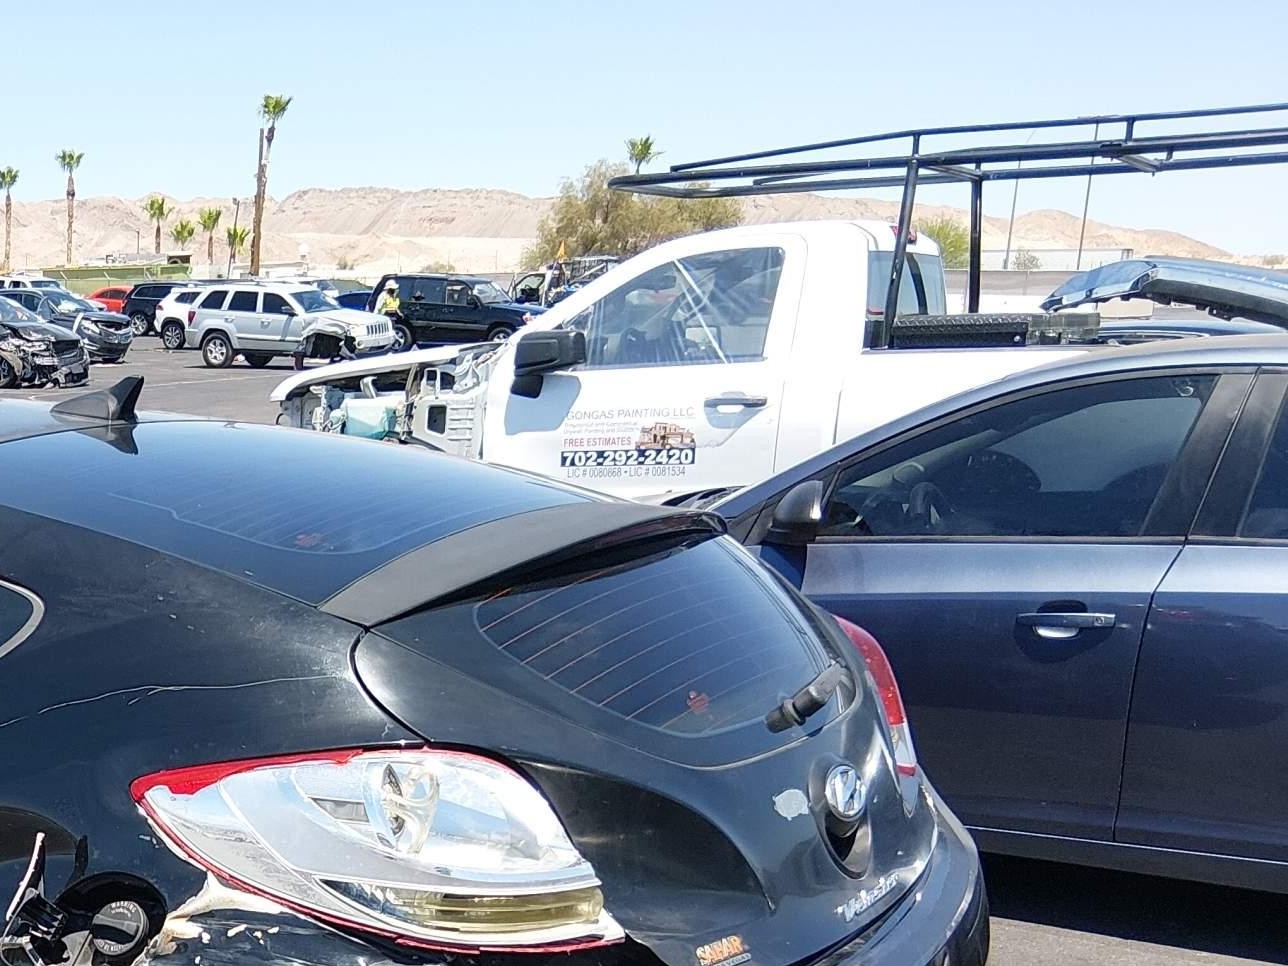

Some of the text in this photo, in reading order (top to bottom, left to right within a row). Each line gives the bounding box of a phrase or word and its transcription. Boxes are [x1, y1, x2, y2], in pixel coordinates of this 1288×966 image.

[617, 407, 670, 418] PAINTING
[672, 406, 695, 417] LLC
[563, 436, 632, 448] FREE ESTIMATES
[563, 450, 693, 466] 702-292-2420
[567, 468, 581, 478] LIC
[581, 468, 588, 477] #
[628, 466, 643, 477] LIC
[643, 466, 650, 475] #
[651, 465, 686, 476] 0081534
